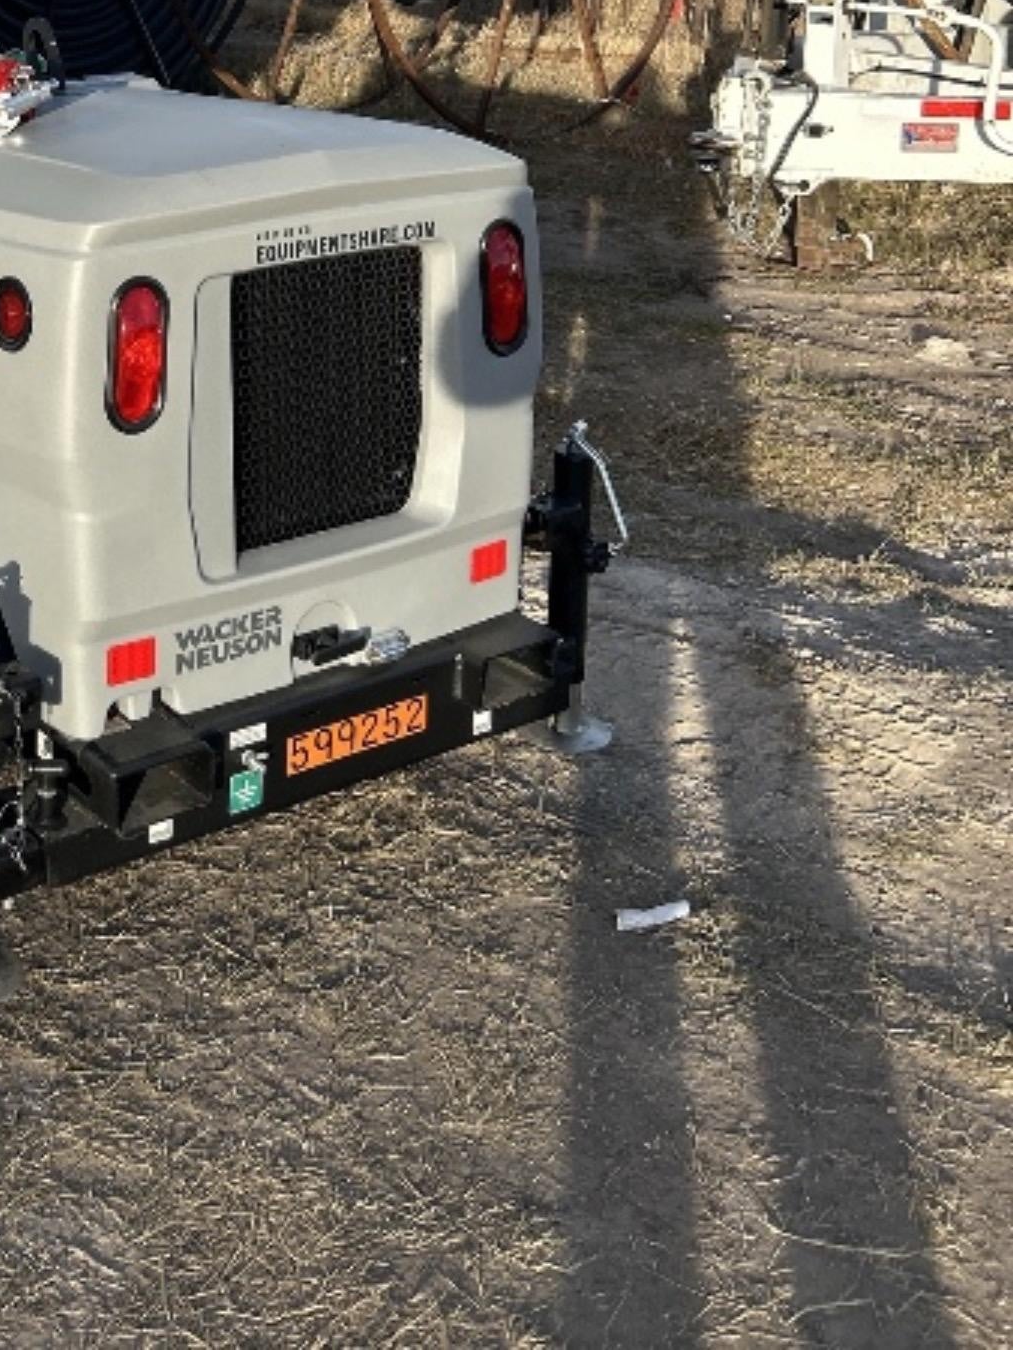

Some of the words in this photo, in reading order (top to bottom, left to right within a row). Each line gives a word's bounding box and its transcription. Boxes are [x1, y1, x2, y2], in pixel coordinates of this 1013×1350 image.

[174, 605, 282, 651] WACKER
[175, 626, 282, 676] NEUSON
[291, 700, 423, 772] 599252
